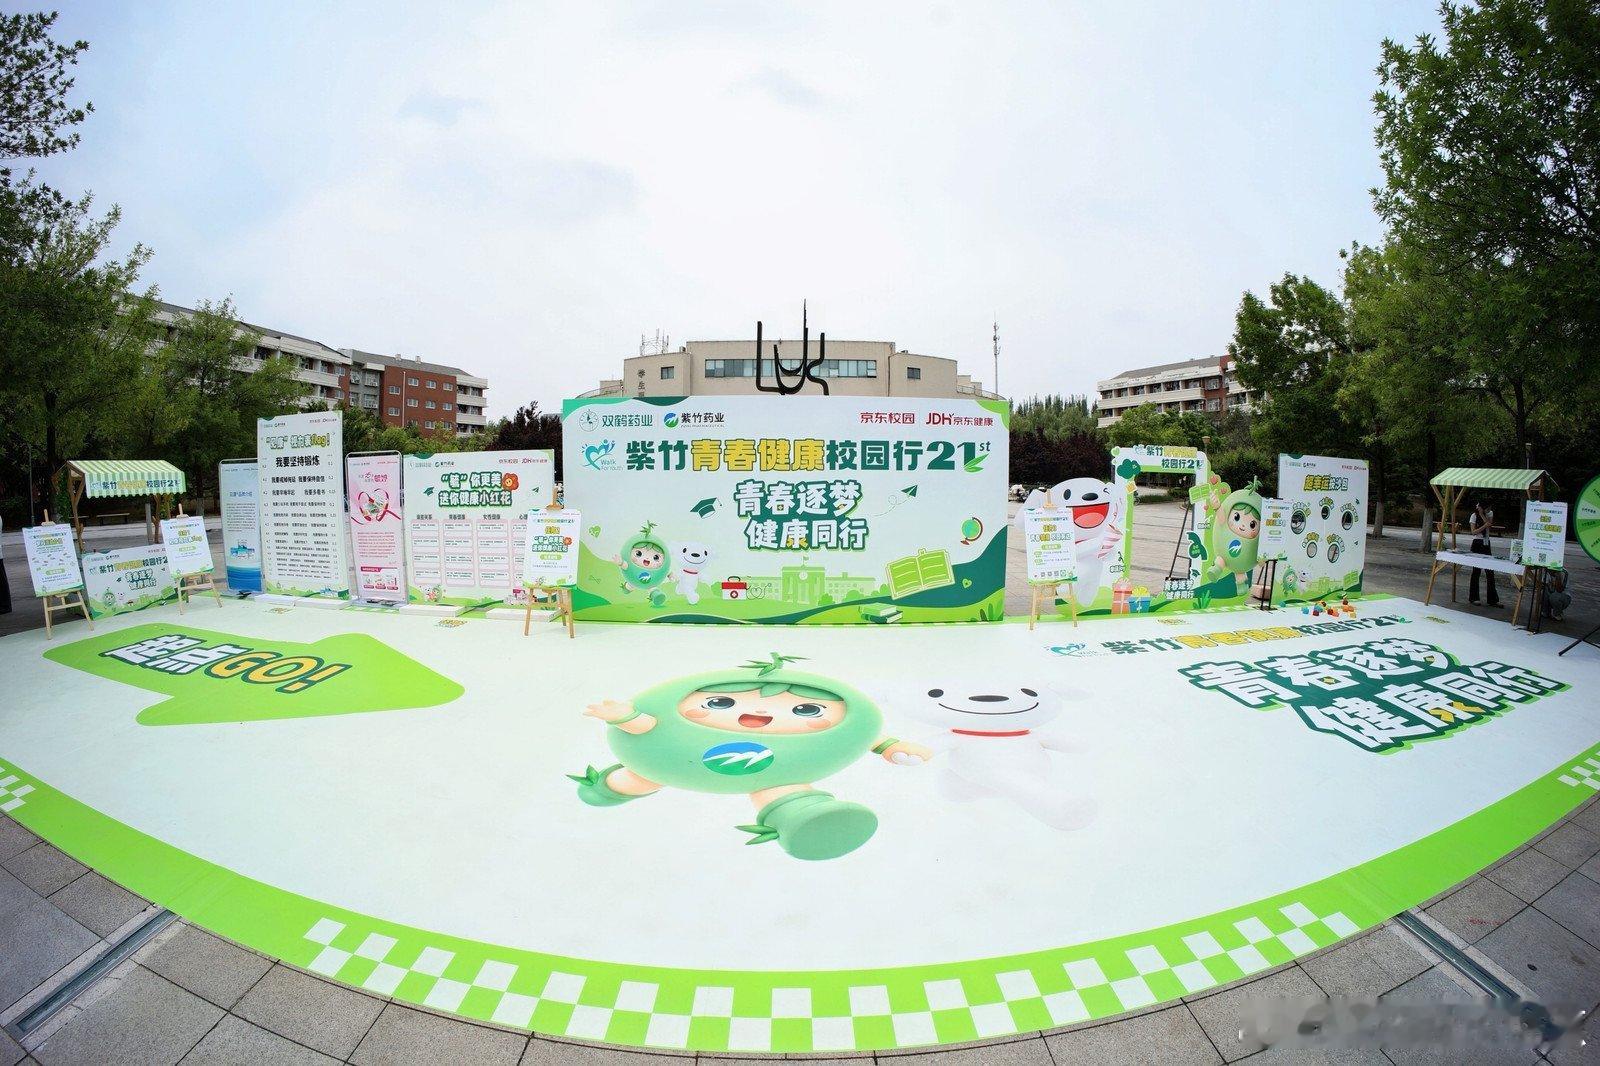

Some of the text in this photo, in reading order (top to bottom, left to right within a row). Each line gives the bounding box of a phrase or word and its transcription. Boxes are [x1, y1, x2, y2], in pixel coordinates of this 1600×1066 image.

[602, 414, 653, 427] 双鹤药业
[681, 412, 725, 423] 紫竹药业
[860, 412, 915, 424] 京东校园
[276, 454, 320, 467] 我要坚持锻炼
[626, 438, 991, 471] 紫竹青春健康校园行21st
[439, 490, 512, 507] 送你健康小红花
[735, 480, 861, 516] 青春逐梦
[746, 518, 867, 549] 健康同行
[1187, 637, 1451, 702] 青春逐梦
[1299, 662, 1564, 749] 健康同行
